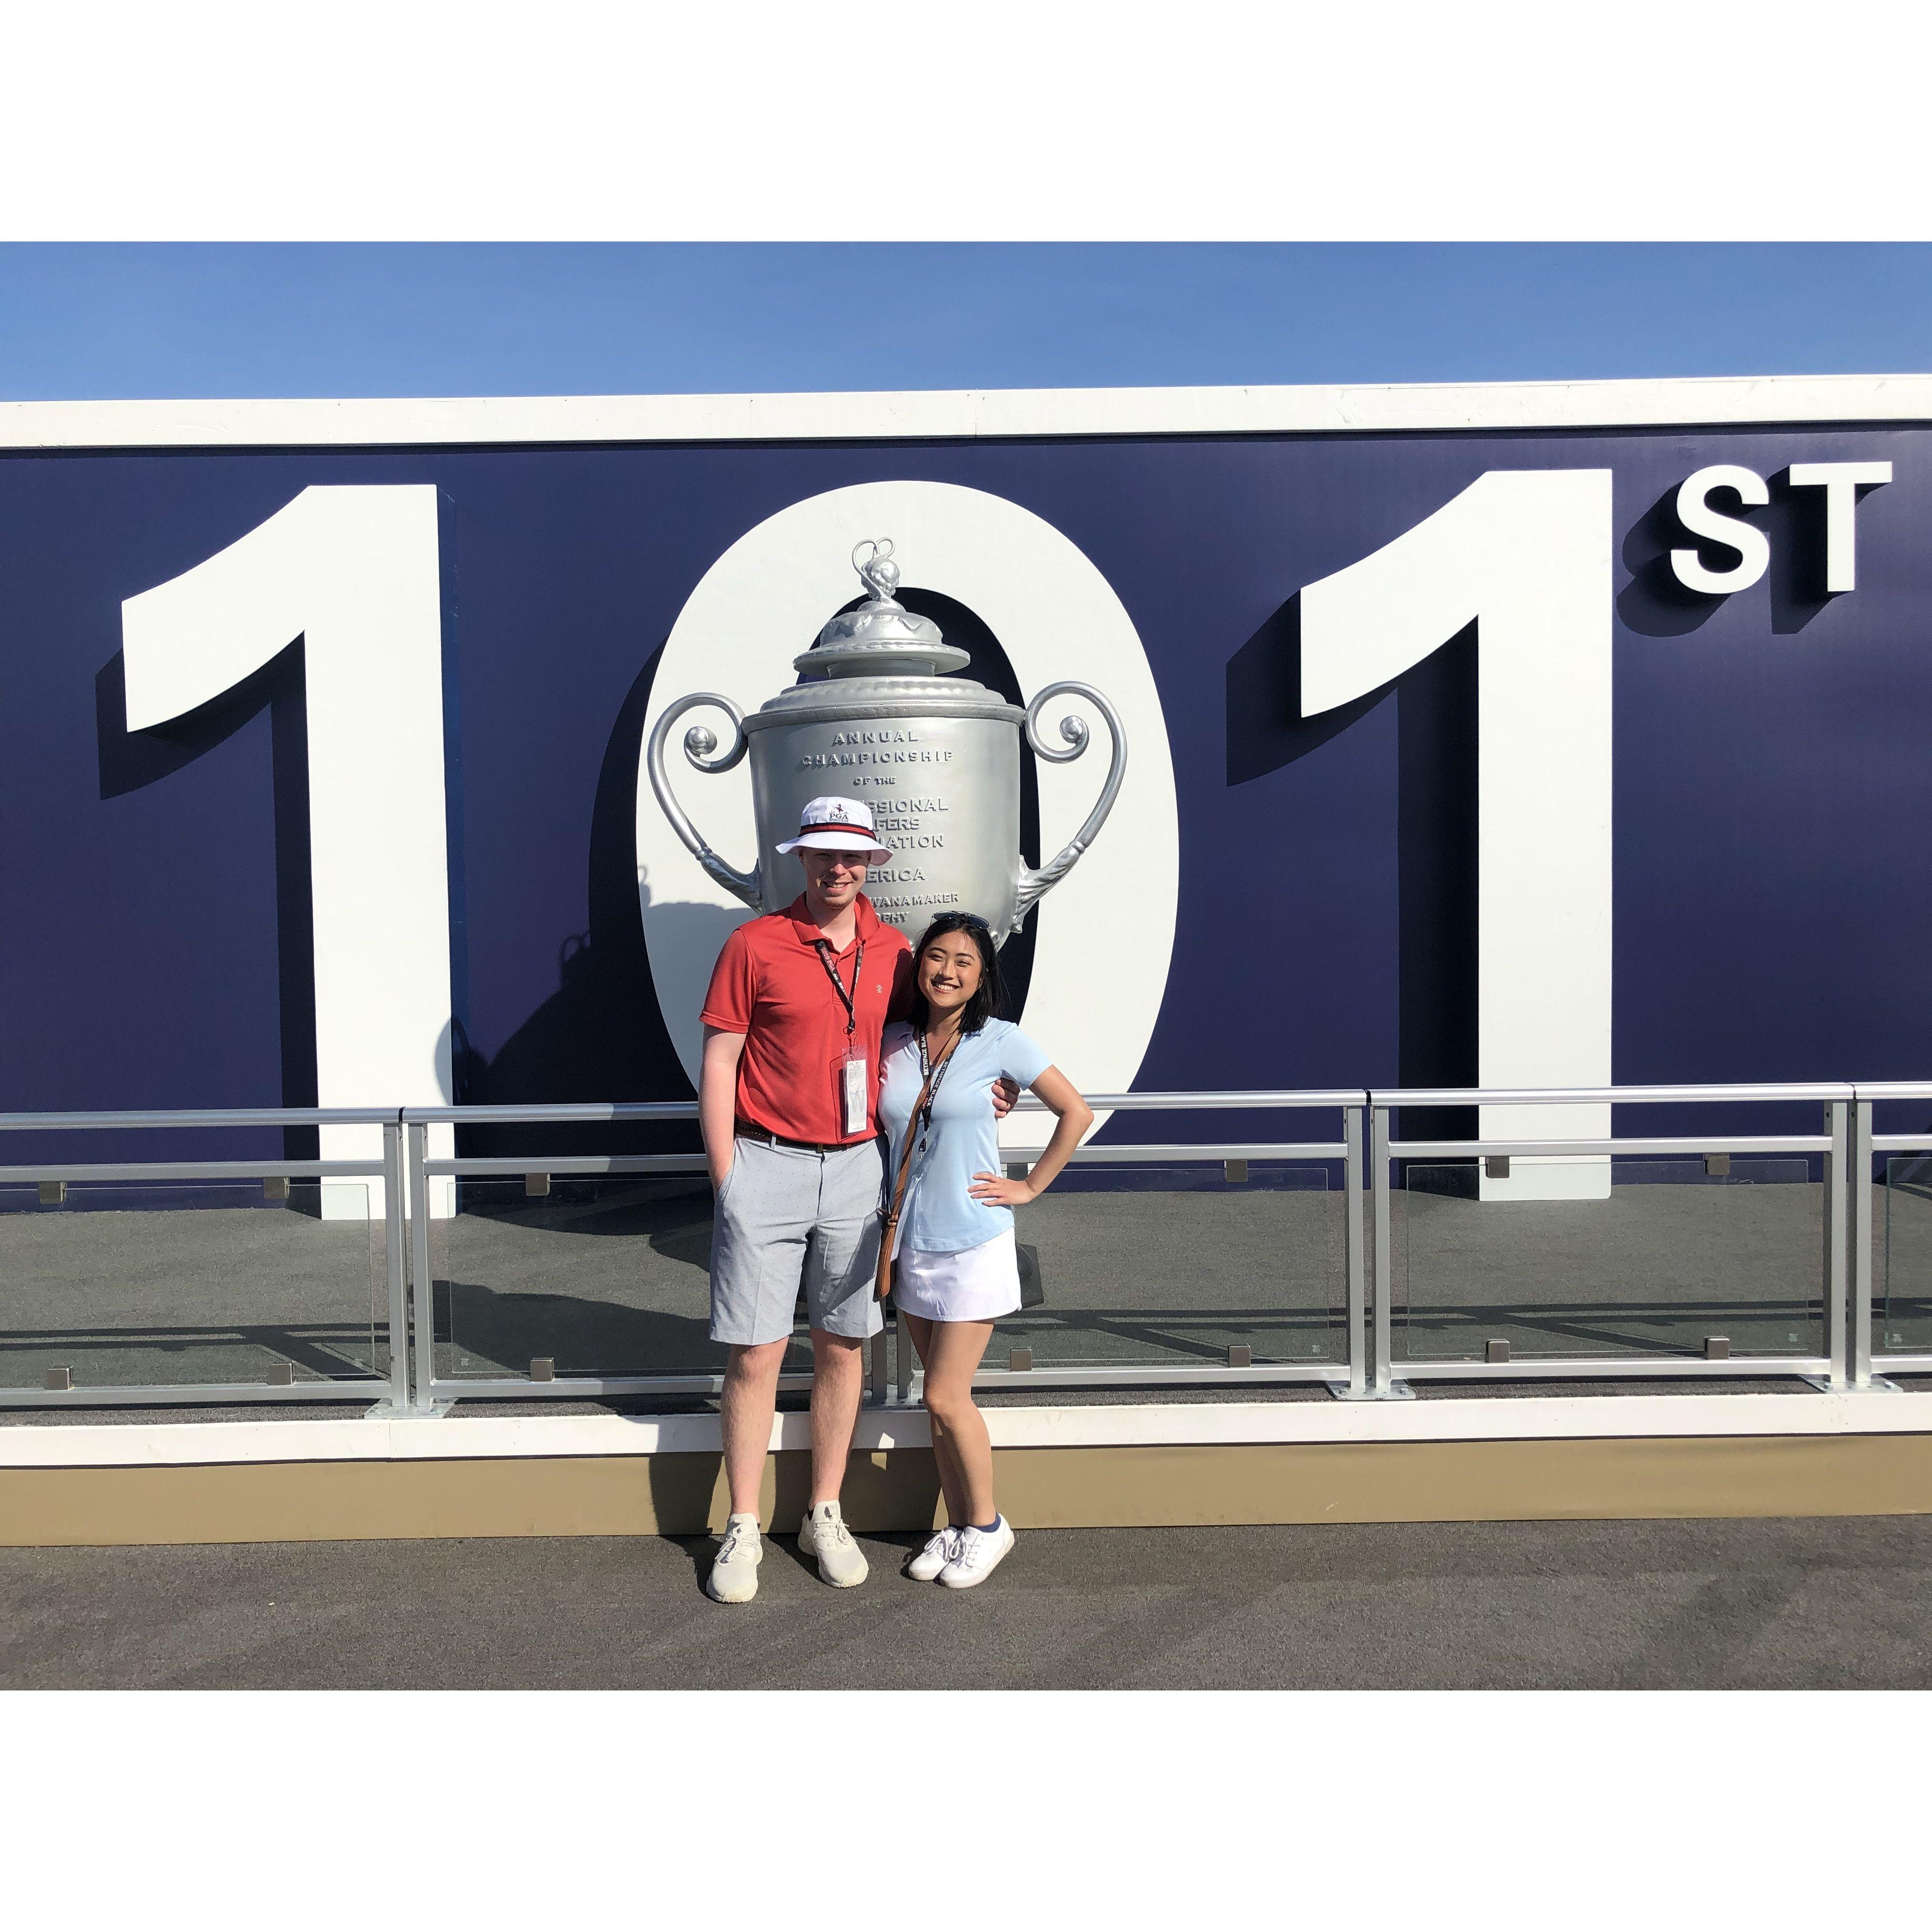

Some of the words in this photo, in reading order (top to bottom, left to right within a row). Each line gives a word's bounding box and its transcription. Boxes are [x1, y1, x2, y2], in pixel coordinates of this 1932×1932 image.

[1670, 461, 1893, 594] ST
[832, 729, 920, 746] ANNUAL
[802, 749, 954, 767] CHAMPIONSHIP
[853, 776, 871, 786] OF
[874, 775, 897, 785] THE
[863, 796, 950, 814] SSIONAL
[874, 816, 921, 832] FERS
[877, 834, 945, 850] IATION
[865, 867, 928, 883] ERICA
[876, 911, 910, 924] PHY
[827, 959, 836, 972] PGA
[934, 1061, 949, 1088] BETHPAGE
[927, 1090, 936, 1106] BLACK
